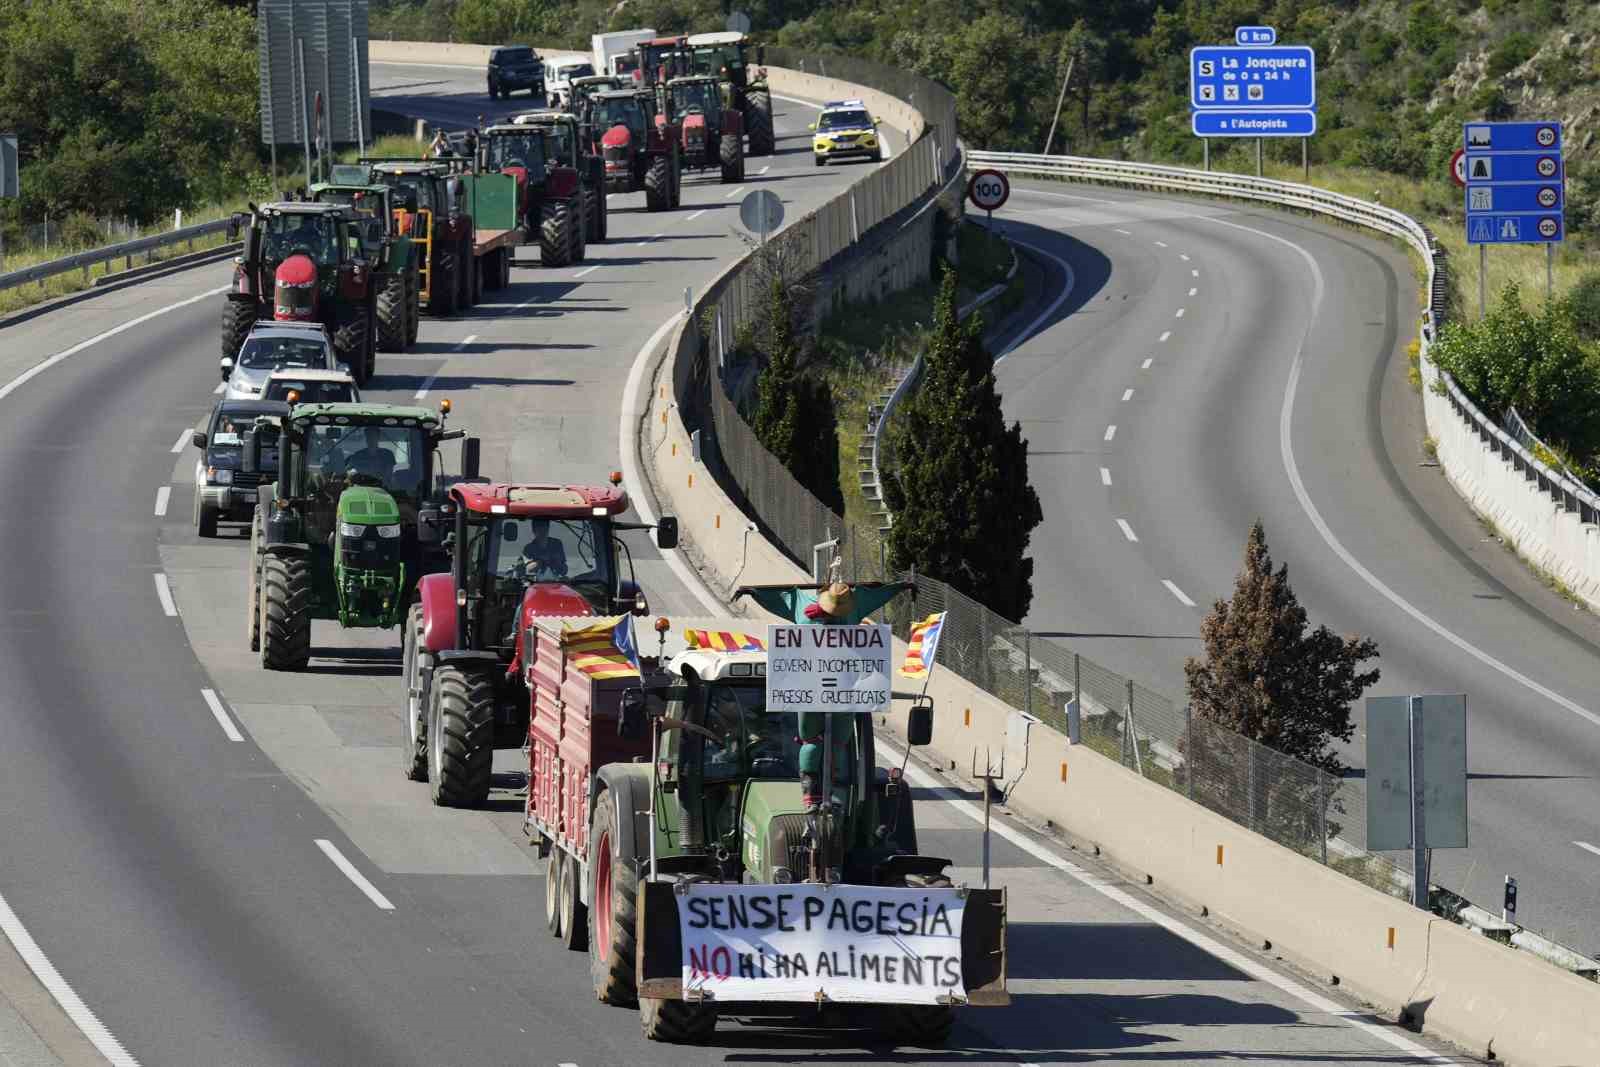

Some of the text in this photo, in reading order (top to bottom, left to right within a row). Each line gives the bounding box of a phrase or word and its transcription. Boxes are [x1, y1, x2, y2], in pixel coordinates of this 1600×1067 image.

[1241, 31, 1271, 41] 6 km
[1201, 63, 1212, 75] S
[1222, 57, 1307, 70] La Jonquera
[1223, 72, 1236, 80] de
[1241, 72, 1249, 80] 0
[1264, 72, 1278, 80] 24
[1283, 72, 1290, 80] h
[1220, 119, 1288, 130] a l'Autopista
[1540, 133, 1552, 141] 50
[976, 183, 1002, 197] 100
[775, 628, 884, 648] EN VENDA
[773, 658, 886, 673] GOVERN INCOMPETENT
[772, 690, 887, 704] PAGESOS CRUCIFICATS
[688, 894, 795, 932] SENSE
[690, 944, 732, 981] NO
[775, 952, 809, 977] HA
